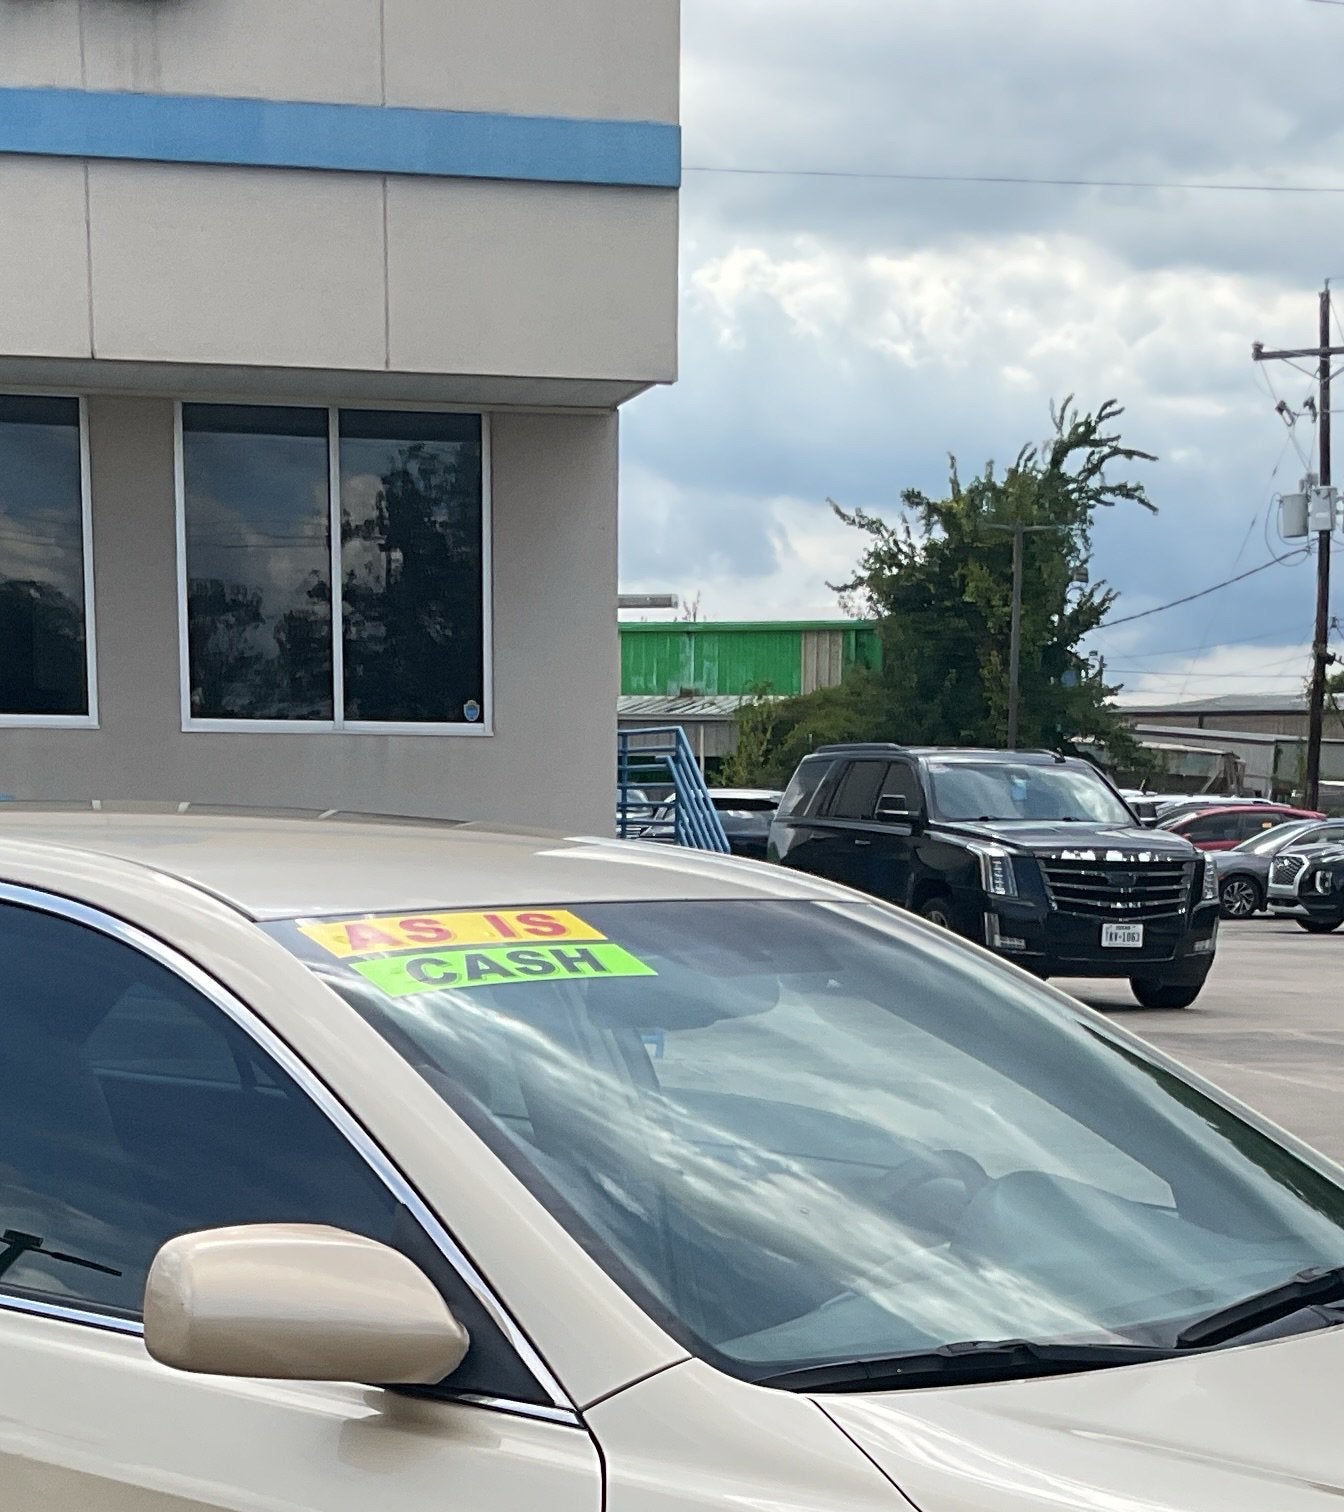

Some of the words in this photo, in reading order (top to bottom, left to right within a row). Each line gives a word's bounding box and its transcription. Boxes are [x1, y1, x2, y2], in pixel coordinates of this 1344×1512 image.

[345, 918, 452, 950] AS
[484, 913, 567, 937] IS
[406, 948, 607, 985] CASH
